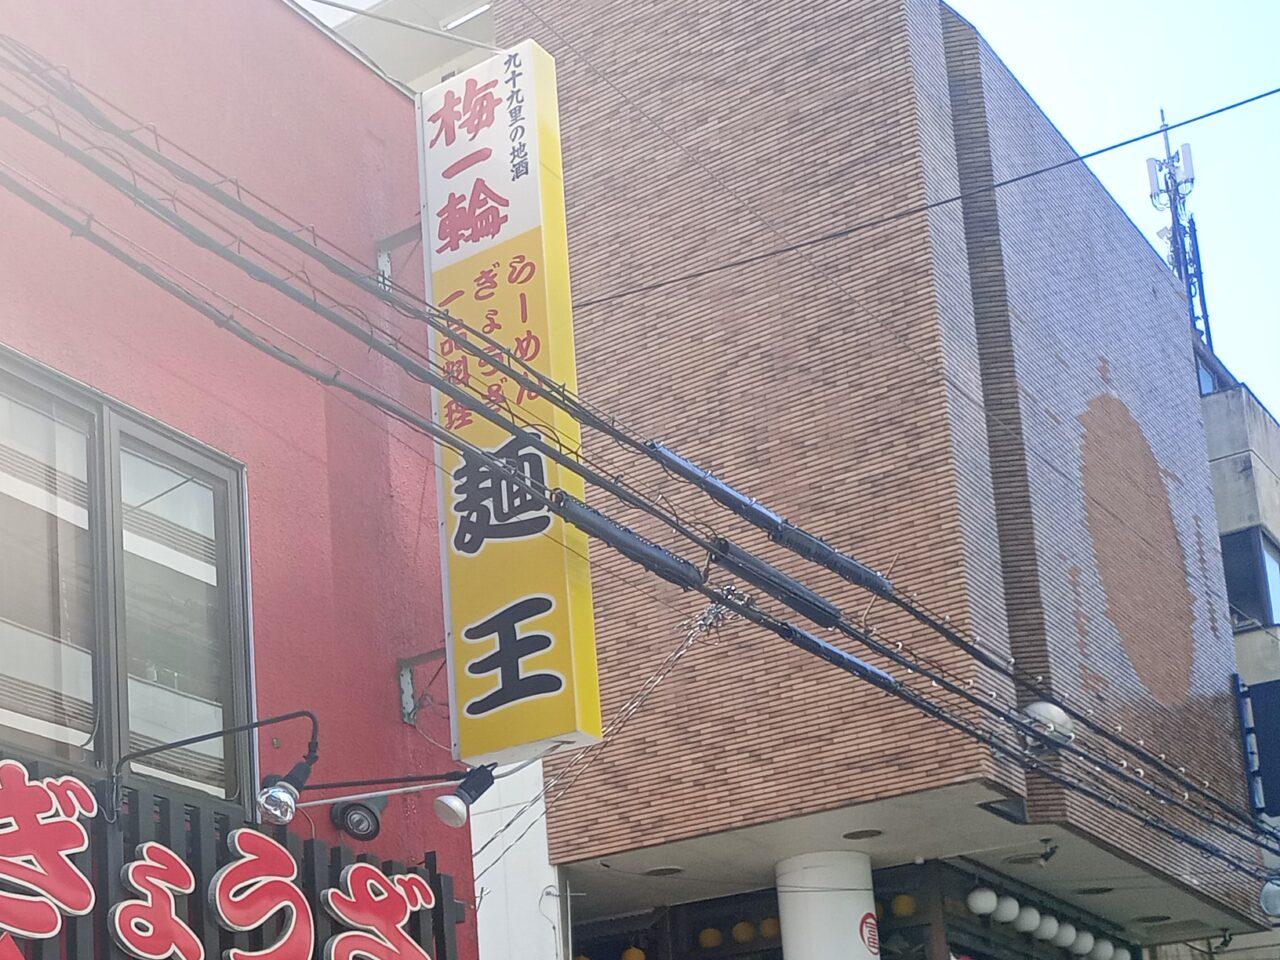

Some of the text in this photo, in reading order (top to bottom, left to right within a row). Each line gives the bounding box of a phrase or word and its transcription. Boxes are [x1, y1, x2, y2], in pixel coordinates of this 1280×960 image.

[427, 77, 510, 254] 梅一輪
[503, 52, 529, 182] 九十九里の地酒
[473, 261, 508, 414] ぎょうざ
[506, 253, 544, 406] らーめん
[452, 431, 563, 717] 麺王
